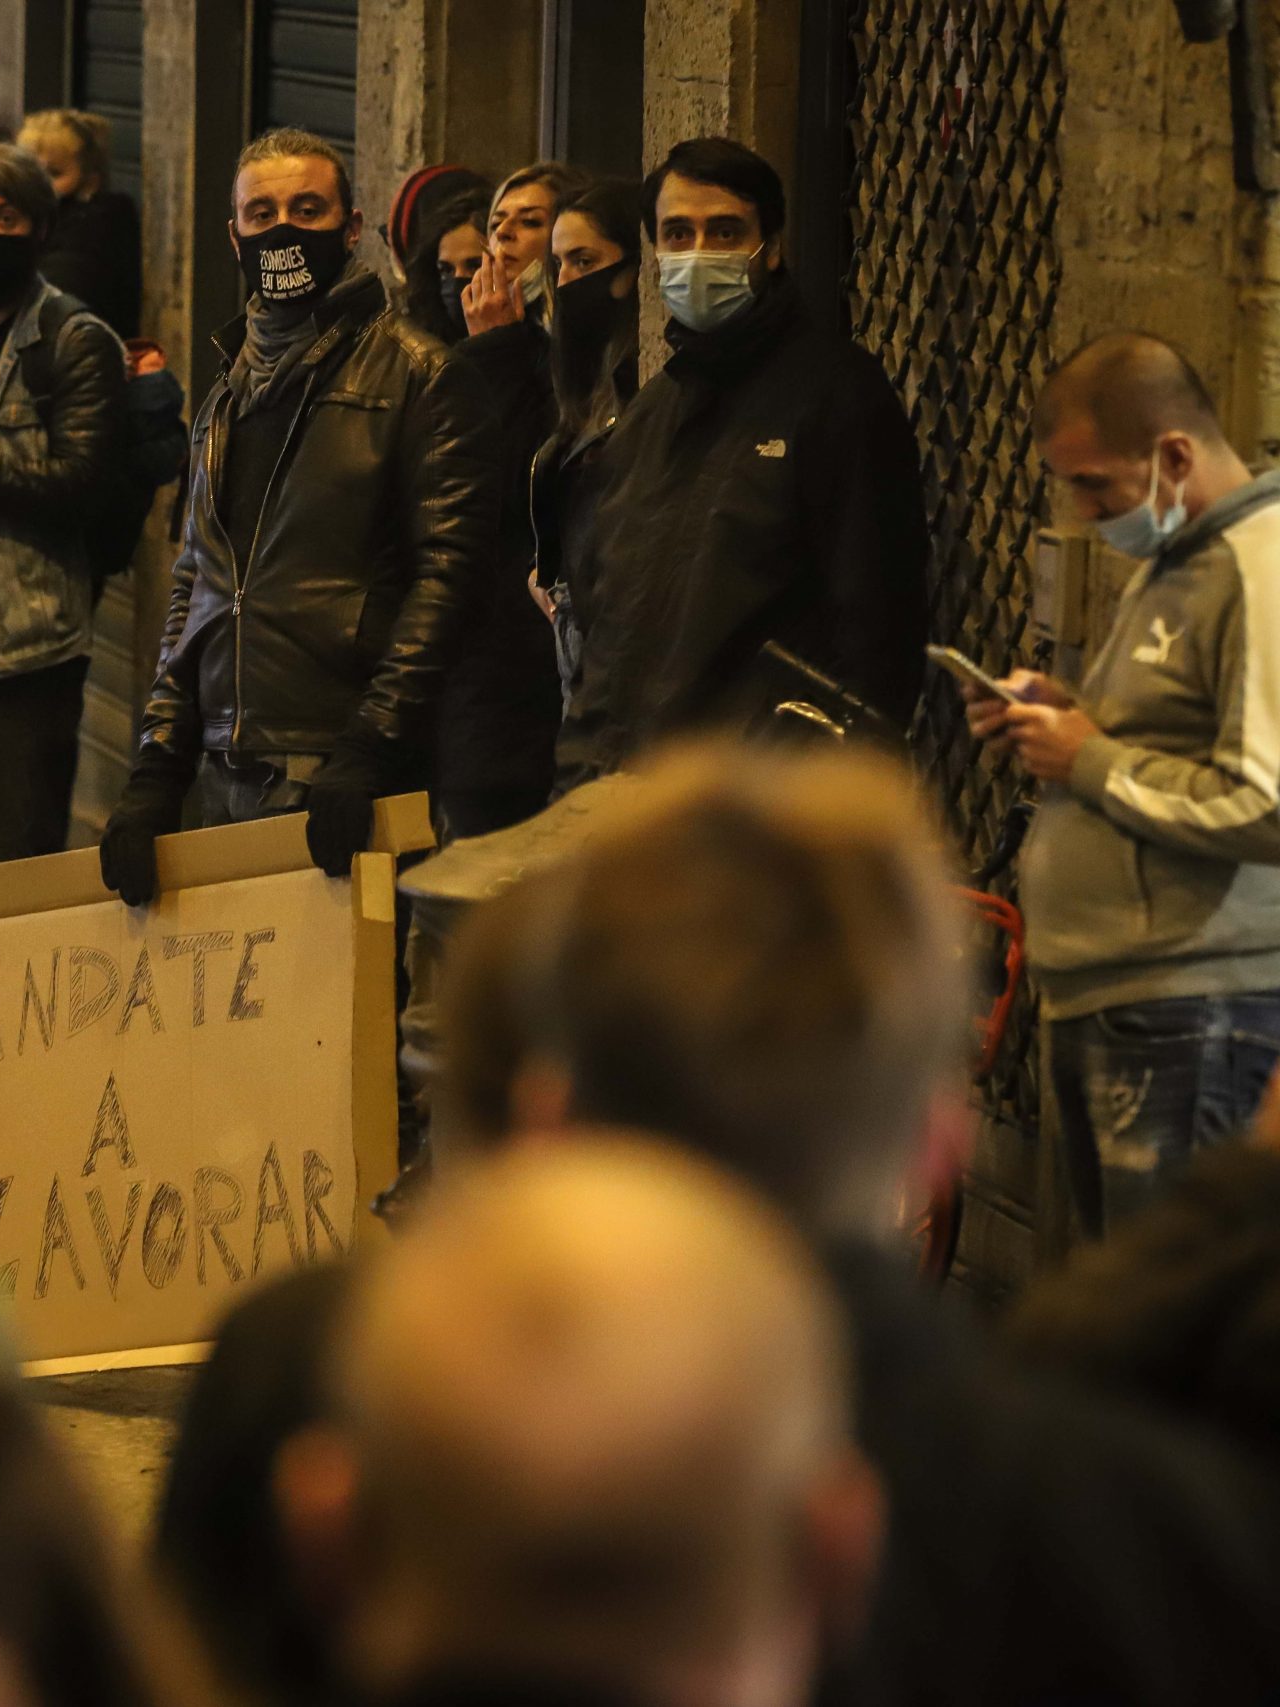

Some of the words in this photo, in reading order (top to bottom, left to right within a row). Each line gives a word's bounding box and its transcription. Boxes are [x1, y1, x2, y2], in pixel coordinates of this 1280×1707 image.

[260, 245, 305, 271] ZOMBIES
[262, 272, 274, 291] EAT
[276, 267, 312, 291] BRAINS
[81, 1070, 137, 1177] A
